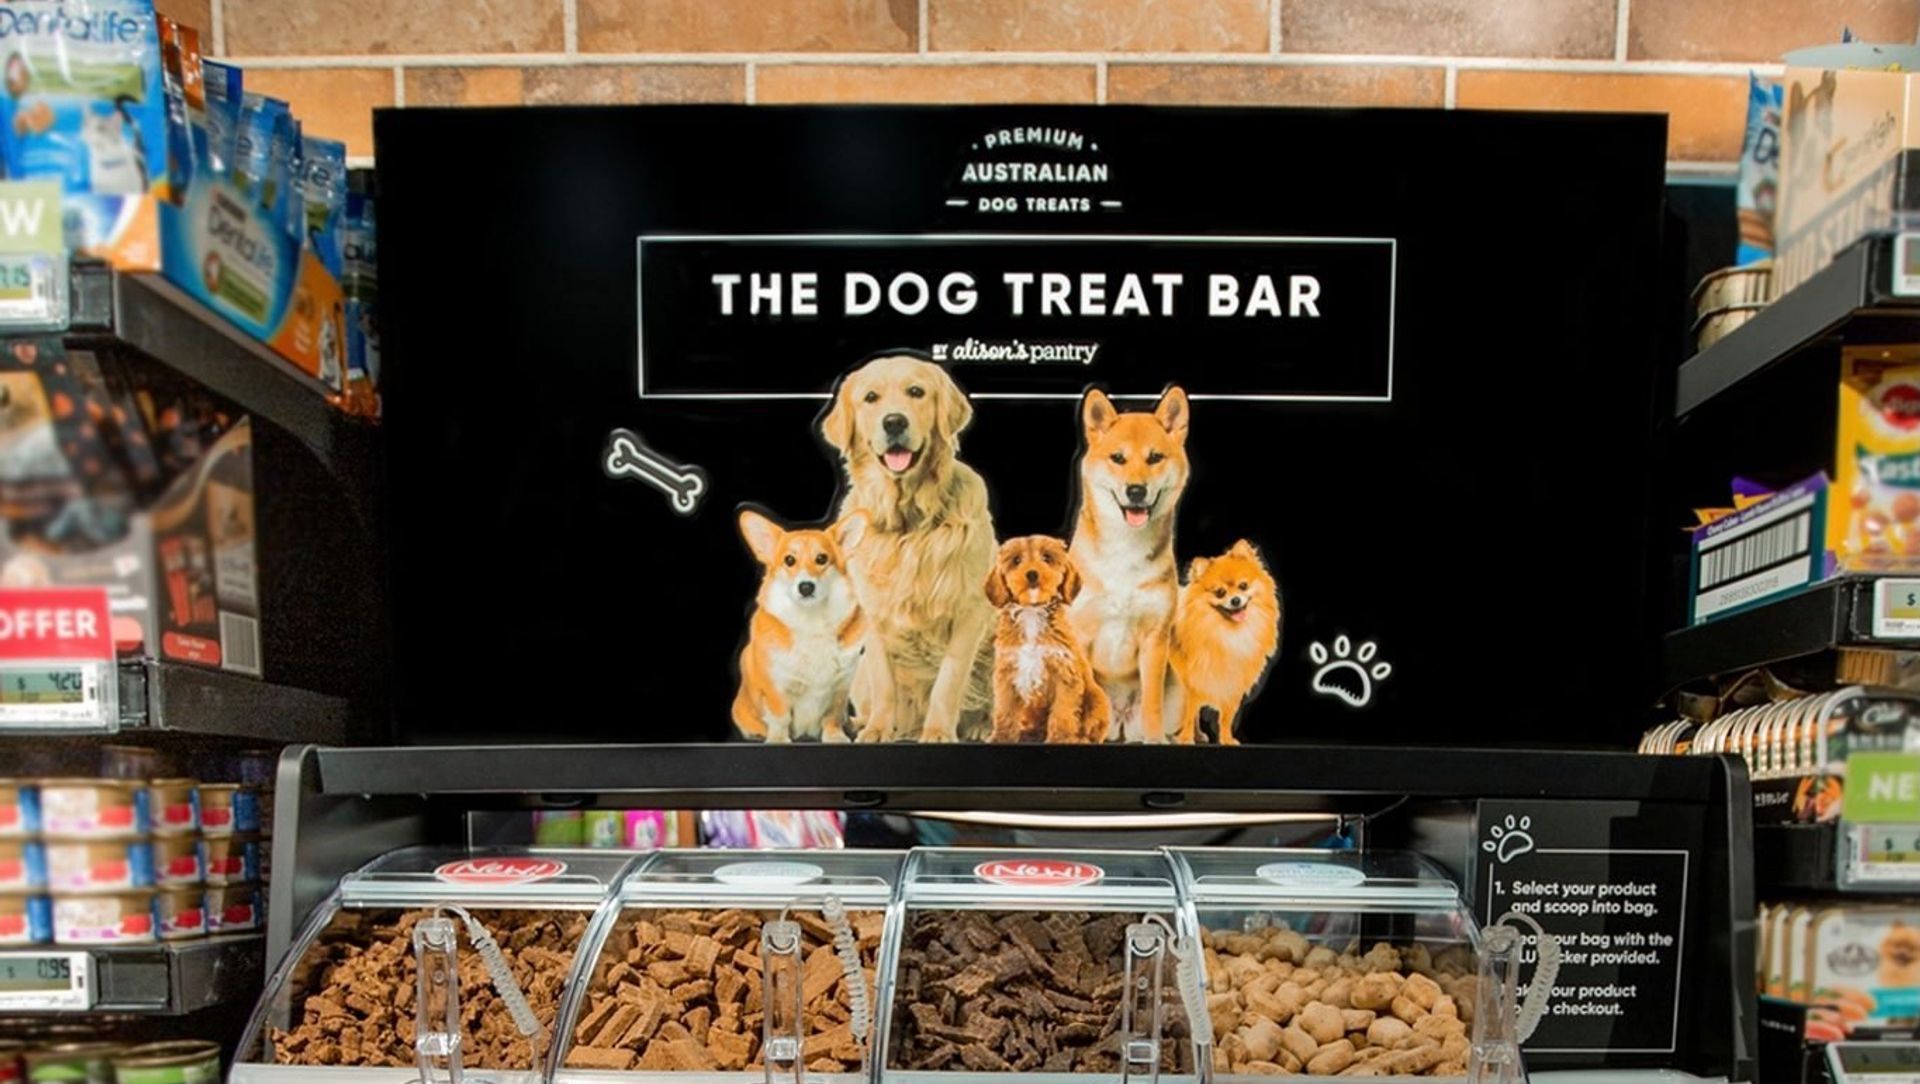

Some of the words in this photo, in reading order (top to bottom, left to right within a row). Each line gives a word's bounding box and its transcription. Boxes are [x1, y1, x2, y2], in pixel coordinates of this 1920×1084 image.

[984, 127, 1083, 150] PREMIUM
[962, 163, 1108, 182] AUSTRALIAN
[978, 198, 1018, 211] DOG
[1026, 198, 1091, 211] TREATS
[712, 273, 818, 315] THE
[845, 272, 978, 315] DOG
[1003, 273, 1183, 316] TREAT
[1208, 274, 1321, 317] BAR
[952, 337, 1029, 360] alison's
[1029, 342, 1100, 365] pantry
[993, 863, 1082, 878] New!
[1494, 881, 1505, 895] 1.
[1512, 880, 1559, 895] Select
[1562, 883, 1596, 899] your
[1598, 881, 1657, 899] product
[1511, 900, 1541, 913] and
[1544, 902, 1589, 917] scoop
[1591, 900, 1621, 913] into
[1624, 900, 1659, 918] bag.
[1553, 934, 1577, 946] our
[1580, 932, 1610, 949] bag
[1613, 932, 1646, 946] with
[1648, 932, 1674, 947] the
[1590, 950, 1661, 967] provided.
[1551, 986, 1577, 997] our
[1578, 984, 1637, 1000] product
[1552, 1002, 1624, 1016] checkout.
